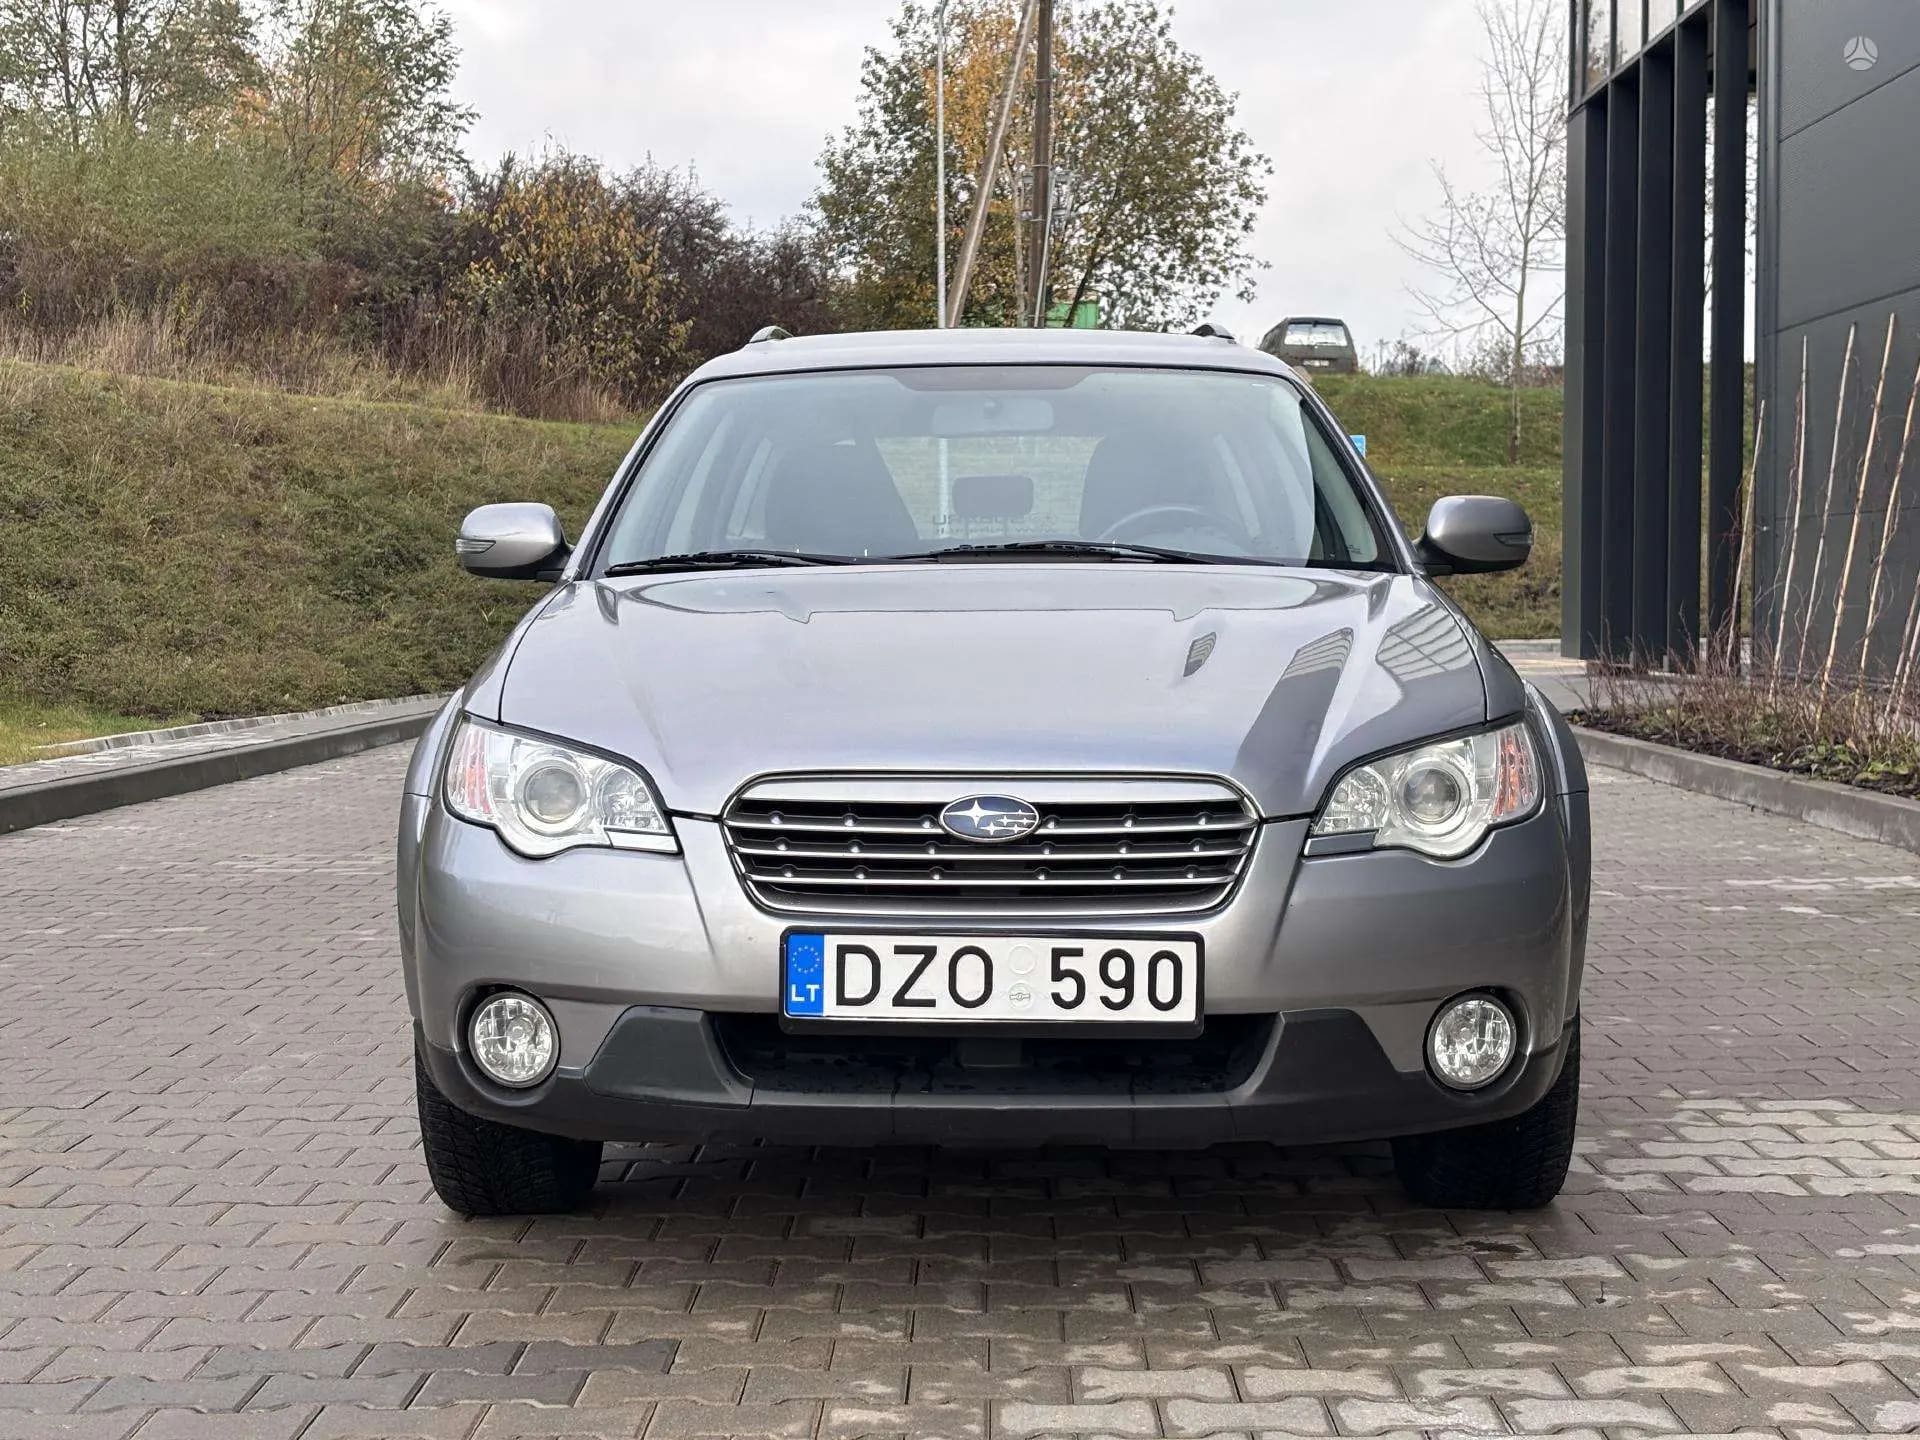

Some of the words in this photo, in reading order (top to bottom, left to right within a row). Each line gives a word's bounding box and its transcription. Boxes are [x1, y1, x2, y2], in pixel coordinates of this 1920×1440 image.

[791, 984, 820, 1002] LT
[836, 944, 994, 1009] DZO
[1050, 947, 1183, 1011] 590
